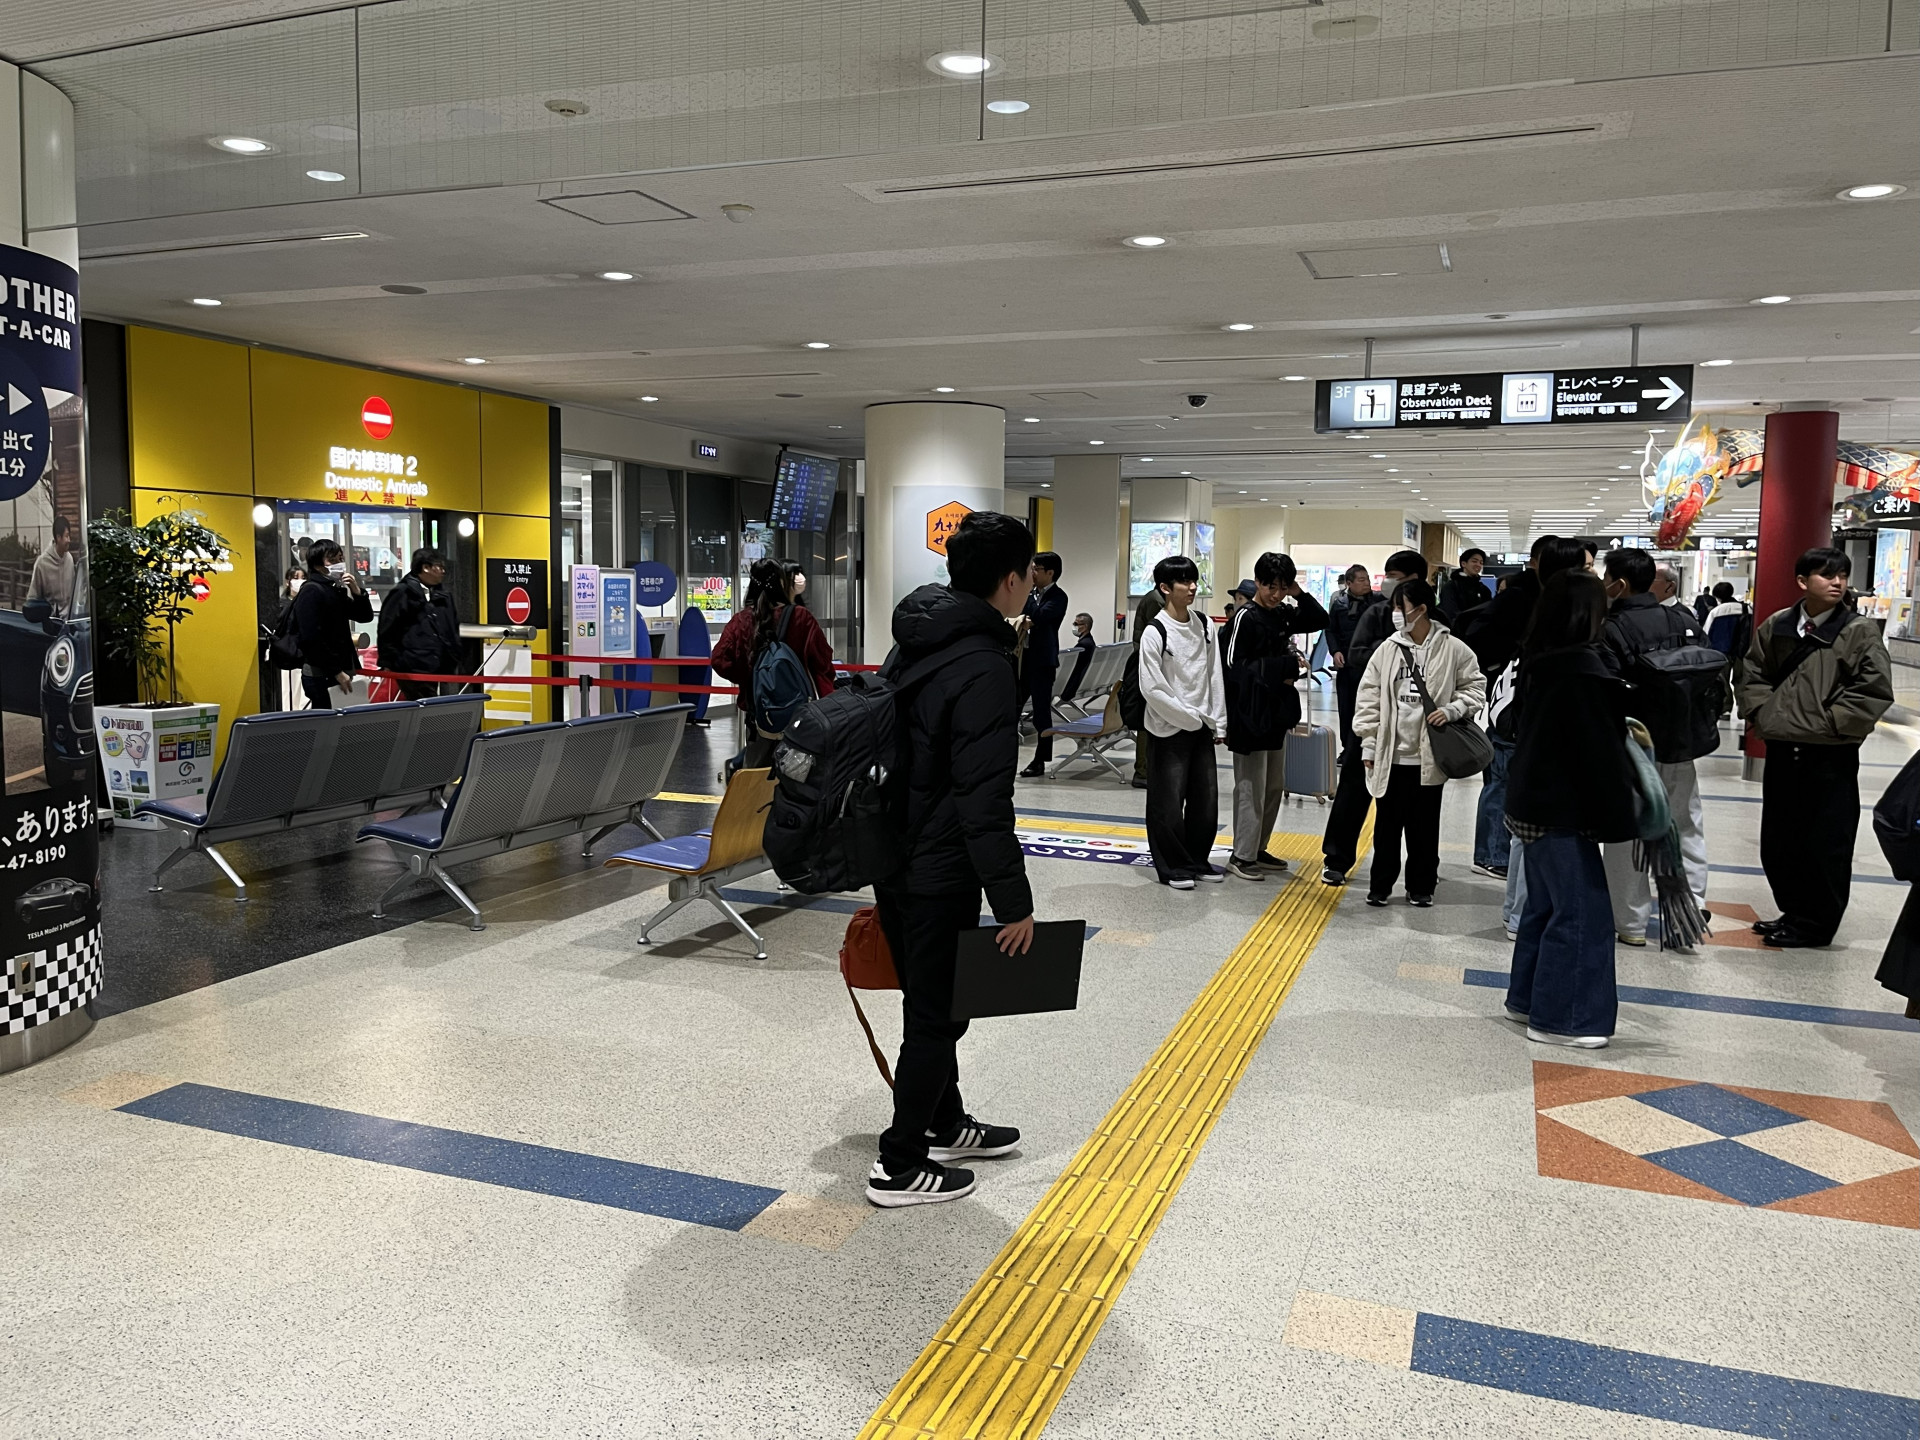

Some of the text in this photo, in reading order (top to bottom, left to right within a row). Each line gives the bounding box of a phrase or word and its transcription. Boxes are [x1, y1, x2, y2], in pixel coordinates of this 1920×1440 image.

[1557, 376, 1639, 390] エレベーター
[1334, 386, 1352, 399] 3F
[1401, 383, 1462, 397] 展望デッキ
[1556, 391, 1603, 402] Elevator
[1400, 395, 1493, 408] Observation Deck
[329, 446, 418, 476] 国内線到着 2
[325, 471, 428, 497] Domestic Arrivals
[334, 487, 417, 507] 進入禁止
[1872, 494, 1911, 514] ご案内
[504, 563, 532, 575] 進入禁止
[515, 576, 529, 585] Entry
[576, 572, 590, 581] JAL
[576, 582, 594, 590] スマイル
[577, 591, 595, 600] サポート
[1399, 695, 1418, 703] NEW
[2, 795, 94, 847] 、あります。
[27, 928, 44, 940] TESLA
[44, 924, 59, 935] Model
